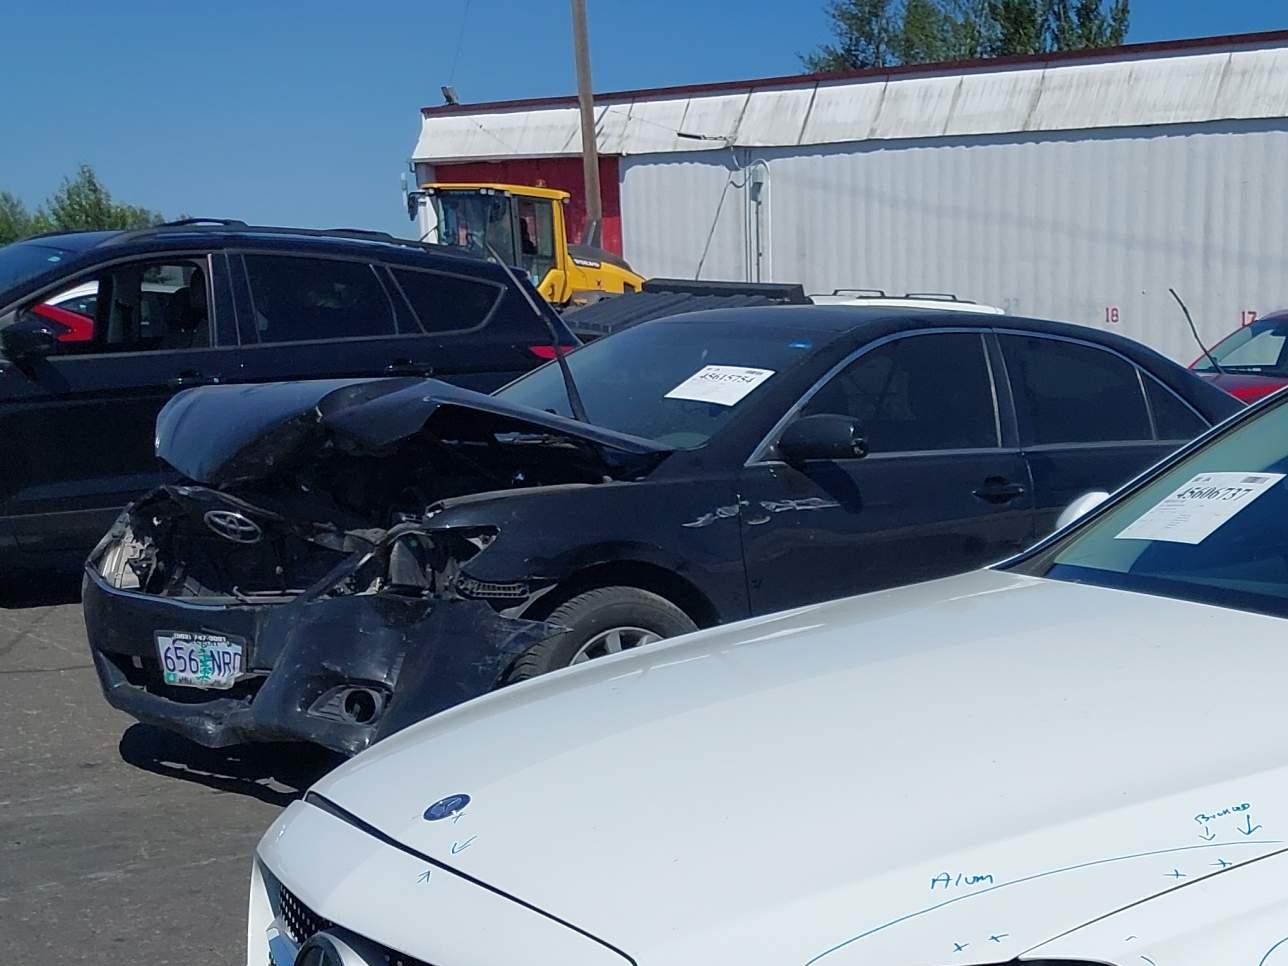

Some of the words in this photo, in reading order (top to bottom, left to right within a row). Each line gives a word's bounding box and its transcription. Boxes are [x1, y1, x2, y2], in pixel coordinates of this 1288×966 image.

[1105, 307, 1120, 323] 18
[1241, 310, 1257, 327] 17
[1176, 486, 1253, 501] 45606737
[164, 646, 200, 675] 656
